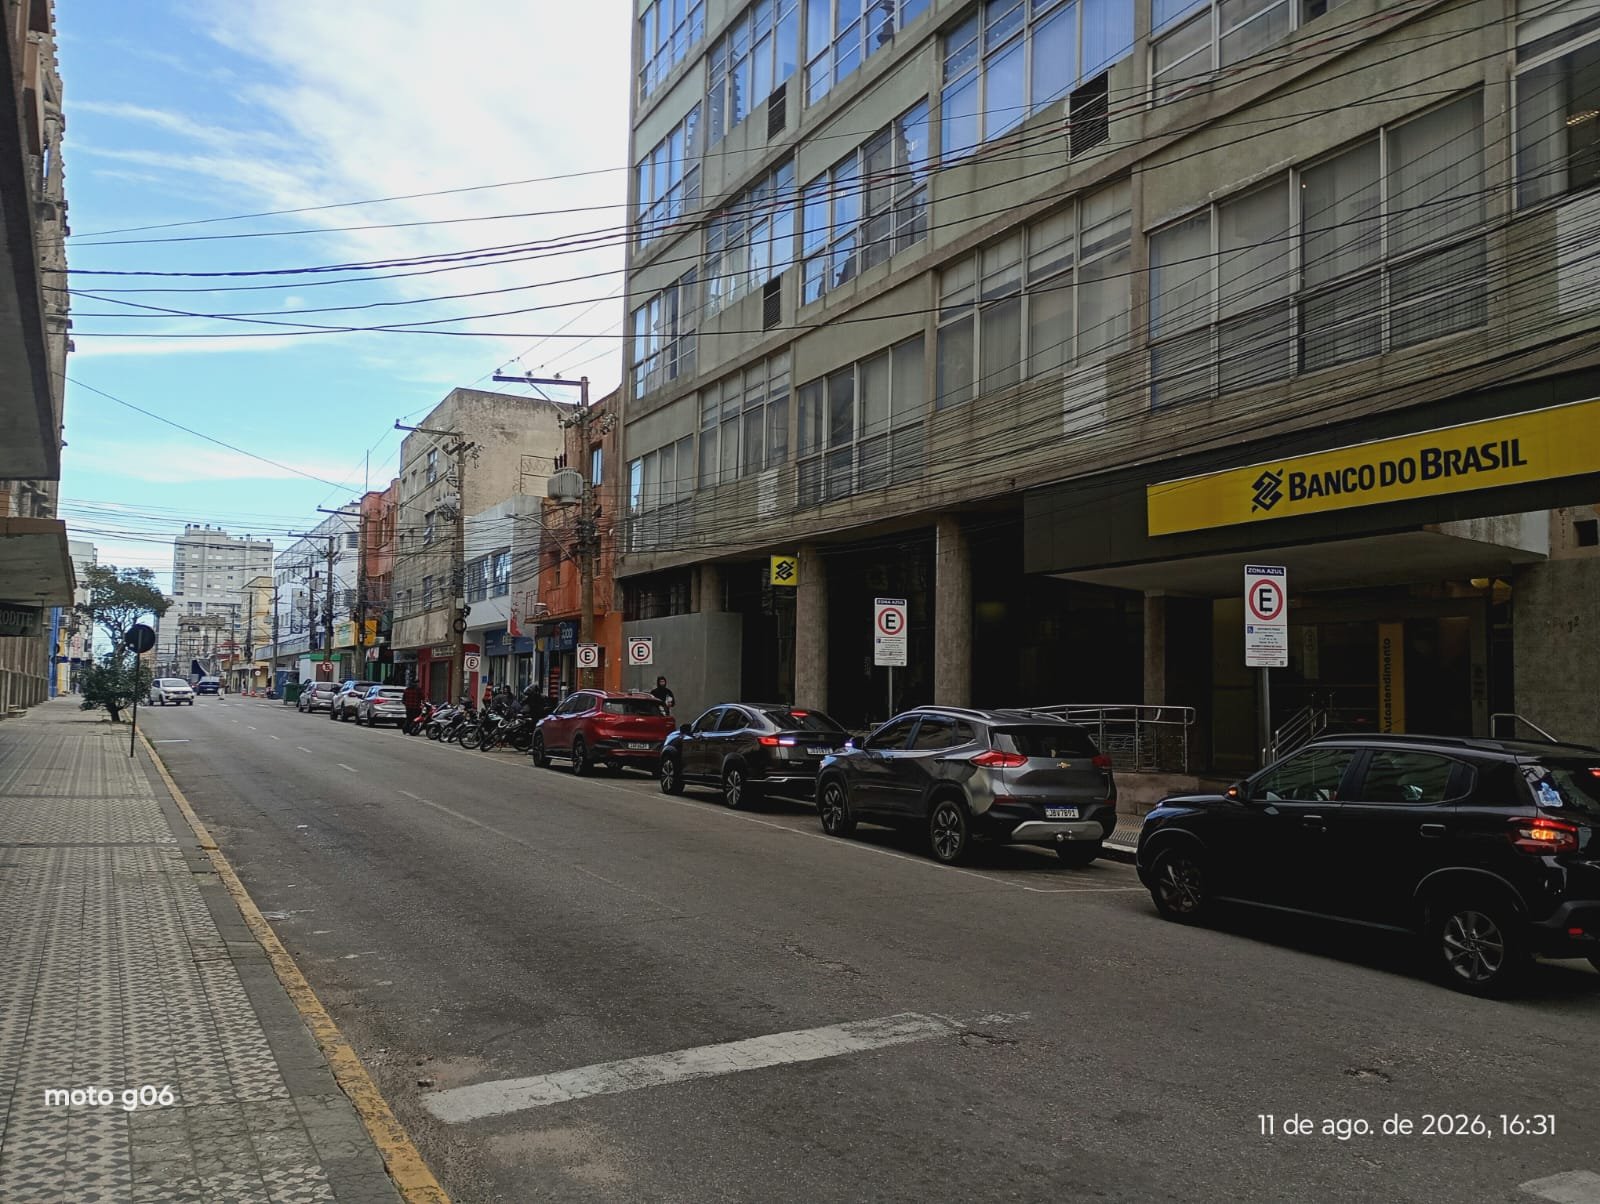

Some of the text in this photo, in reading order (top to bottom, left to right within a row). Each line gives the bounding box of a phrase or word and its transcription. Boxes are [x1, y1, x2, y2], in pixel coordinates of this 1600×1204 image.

[1289, 438, 1527, 502] BANCO DO BRASIL
[1259, 588, 1273, 612] E
[885, 613, 897, 630] E
[584, 651, 591, 661] E
[637, 646, 644, 657] E
